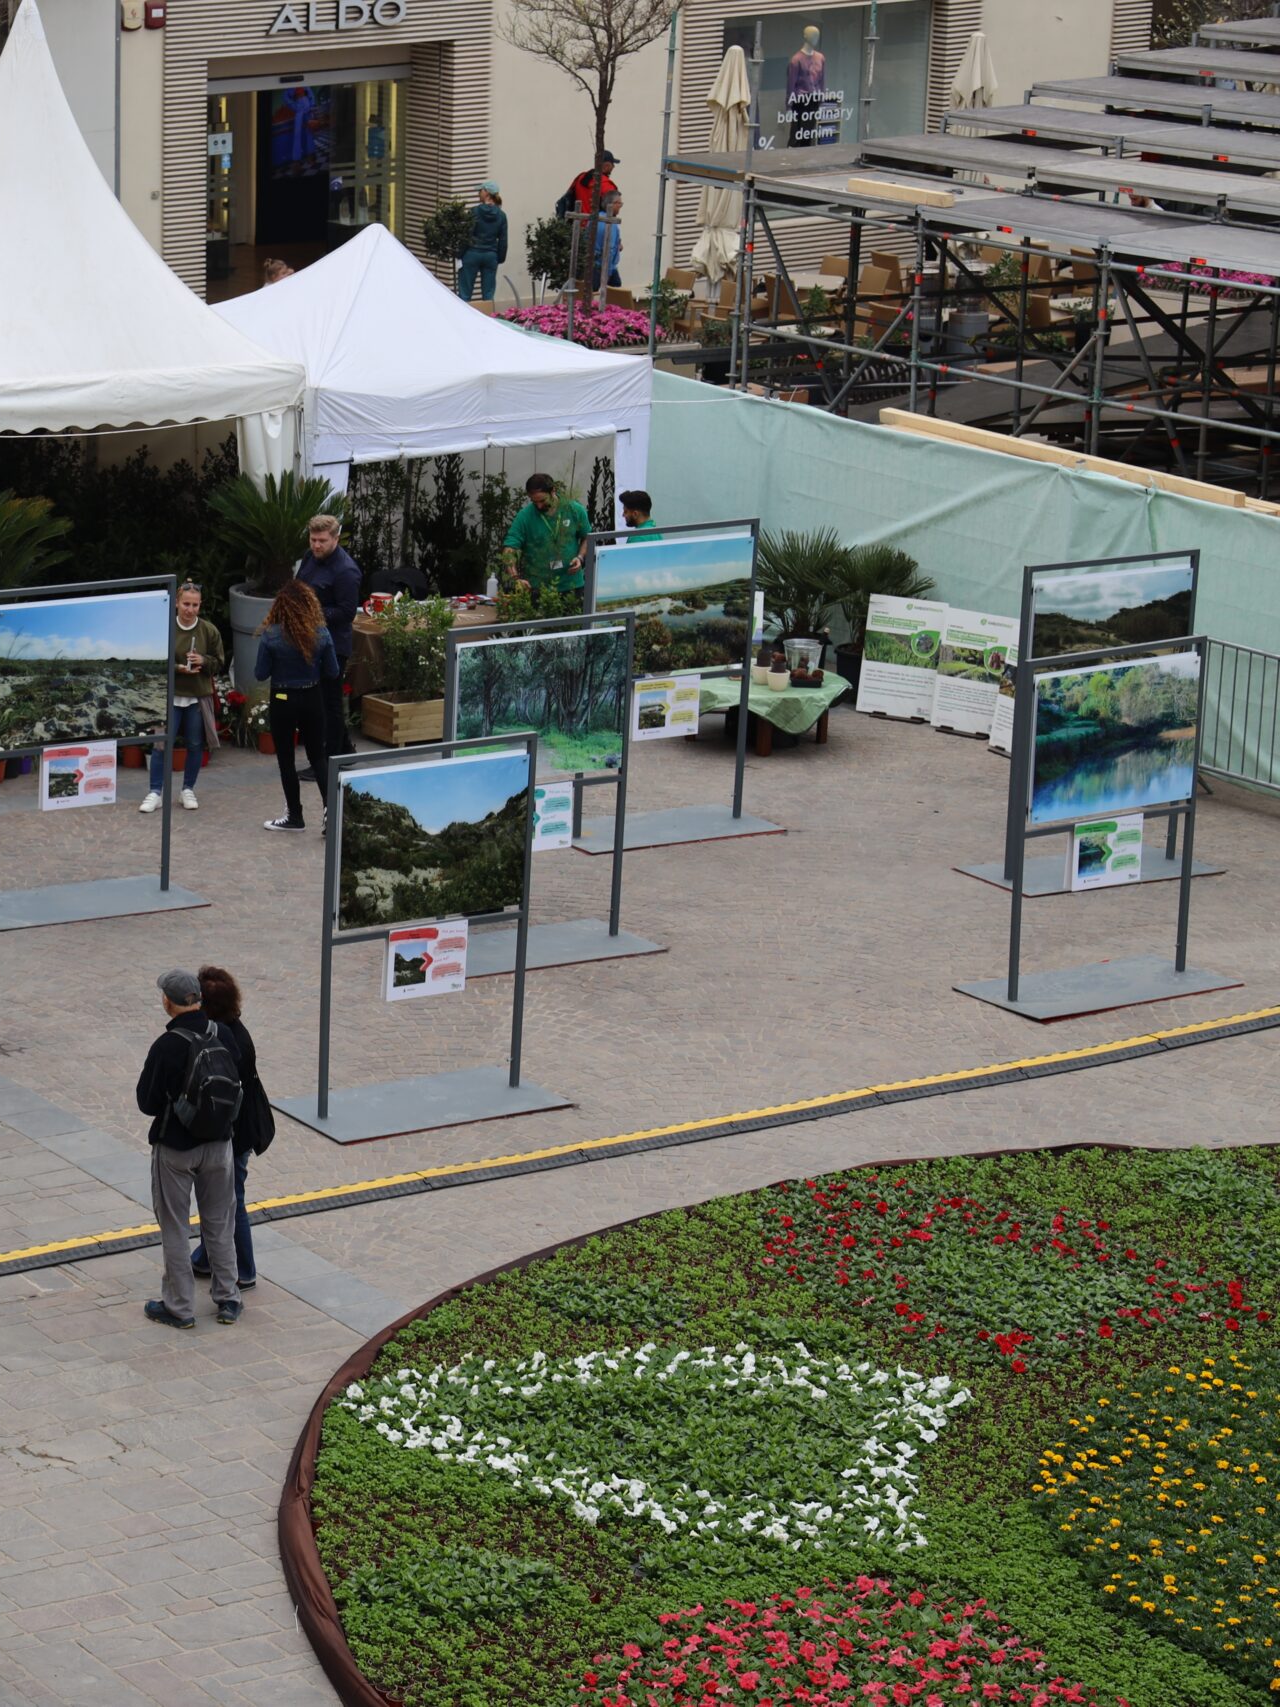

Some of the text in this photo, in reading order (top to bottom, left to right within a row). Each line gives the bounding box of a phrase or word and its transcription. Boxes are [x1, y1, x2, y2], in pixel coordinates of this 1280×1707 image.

[268, 0, 407, 34] ALDO
[788, 88, 844, 105] Anything
[778, 107, 853, 123] but ordinary
[795, 125, 833, 140] denim
